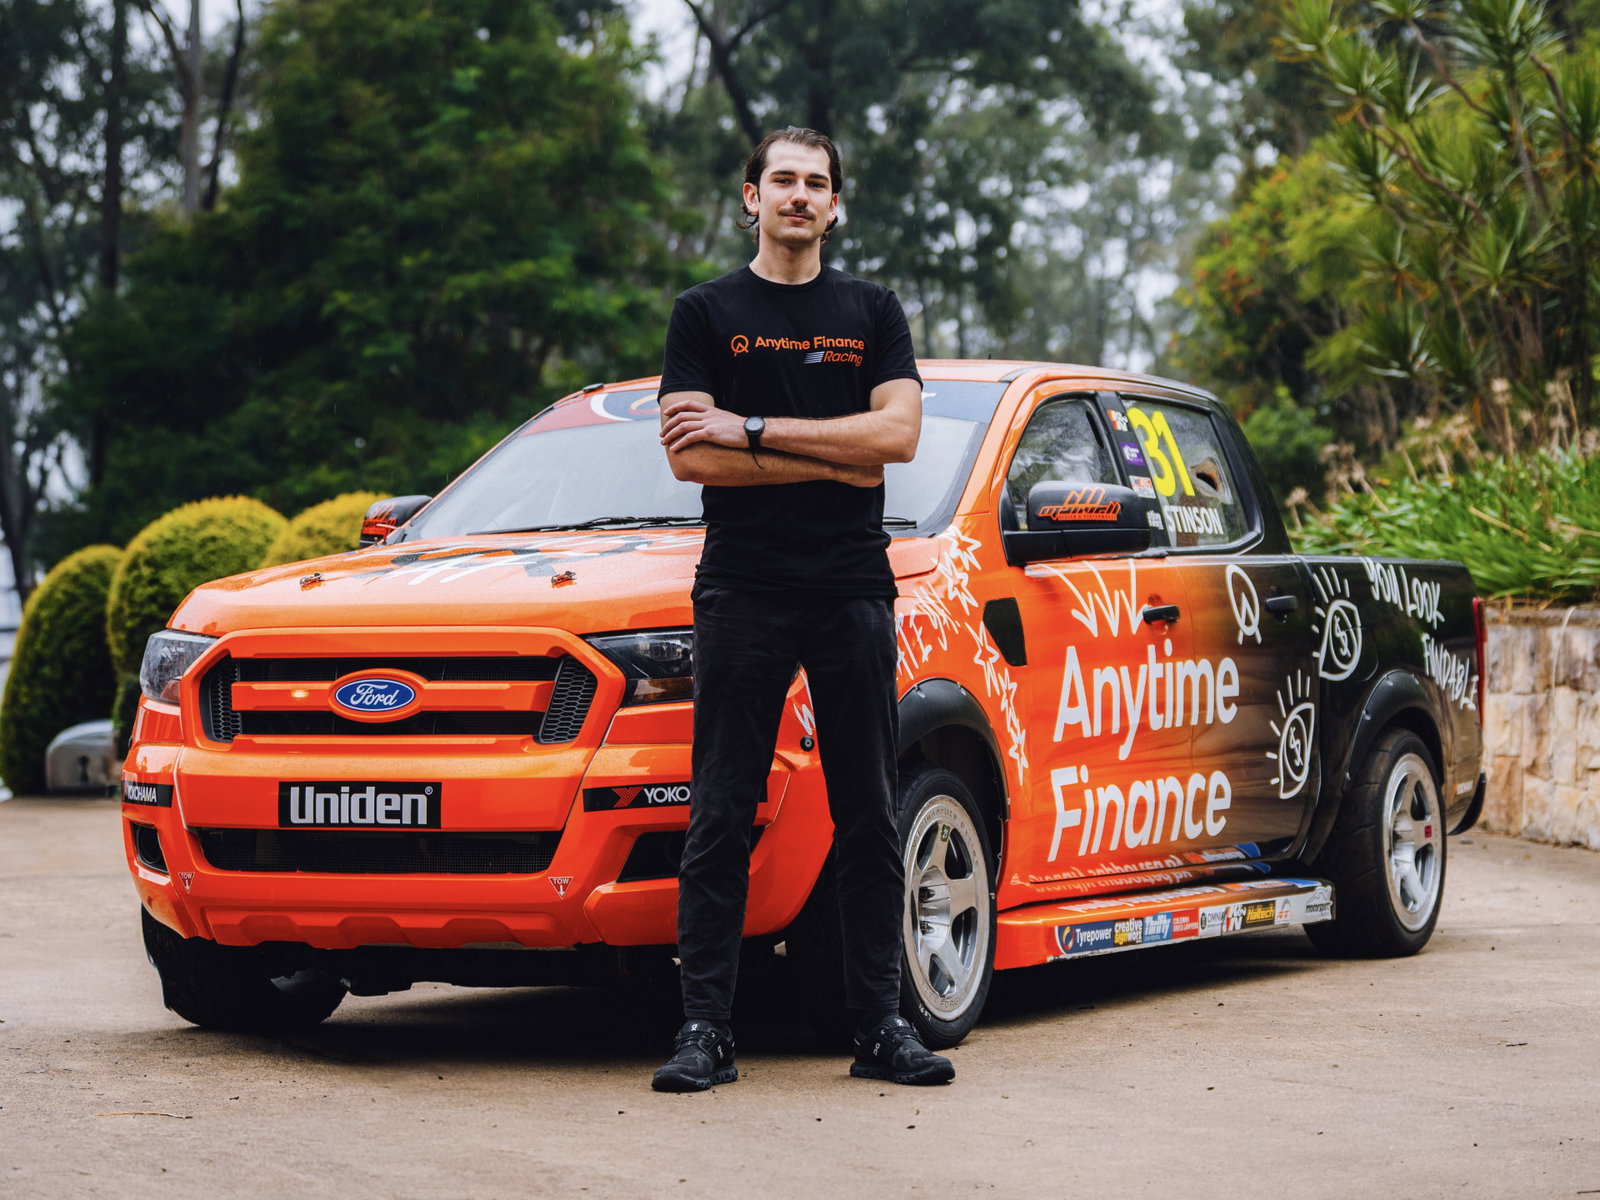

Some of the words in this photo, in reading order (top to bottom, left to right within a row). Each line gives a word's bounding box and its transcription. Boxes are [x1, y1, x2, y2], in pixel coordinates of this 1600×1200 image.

[755, 336, 811, 351] Anytime
[813, 335, 865, 350] Finance
[823, 350, 863, 367] Racing
[1127, 407, 1196, 497] 31
[1163, 504, 1224, 535] STINSON
[350, 683, 400, 706] Ford
[1053, 638, 1240, 761] Anytime
[643, 786, 691, 804] YOKO
[1047, 764, 1233, 863] Finance
[1247, 903, 1275, 923] Haltech
[1114, 917, 1143, 933] creative
[1075, 927, 1113, 947] Tyrepower
